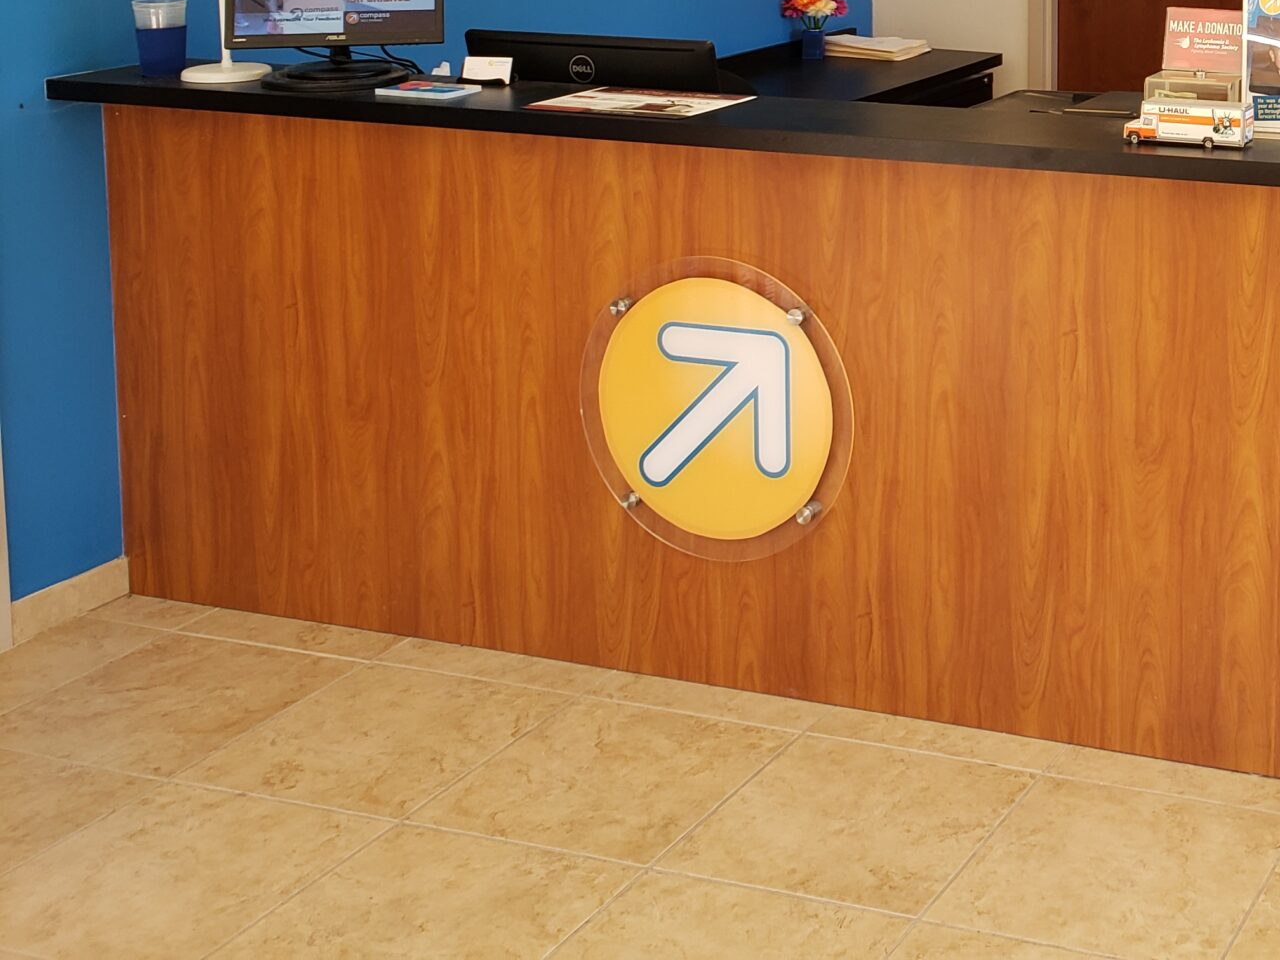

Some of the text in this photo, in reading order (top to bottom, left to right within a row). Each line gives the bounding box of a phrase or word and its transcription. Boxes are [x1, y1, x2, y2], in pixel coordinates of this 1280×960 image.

[359, 12, 390, 20] compass
[1169, 20, 1243, 36] MAKE A DONATIO
[572, 63, 593, 74] DELL
[1158, 107, 1190, 115] U-HAUL
